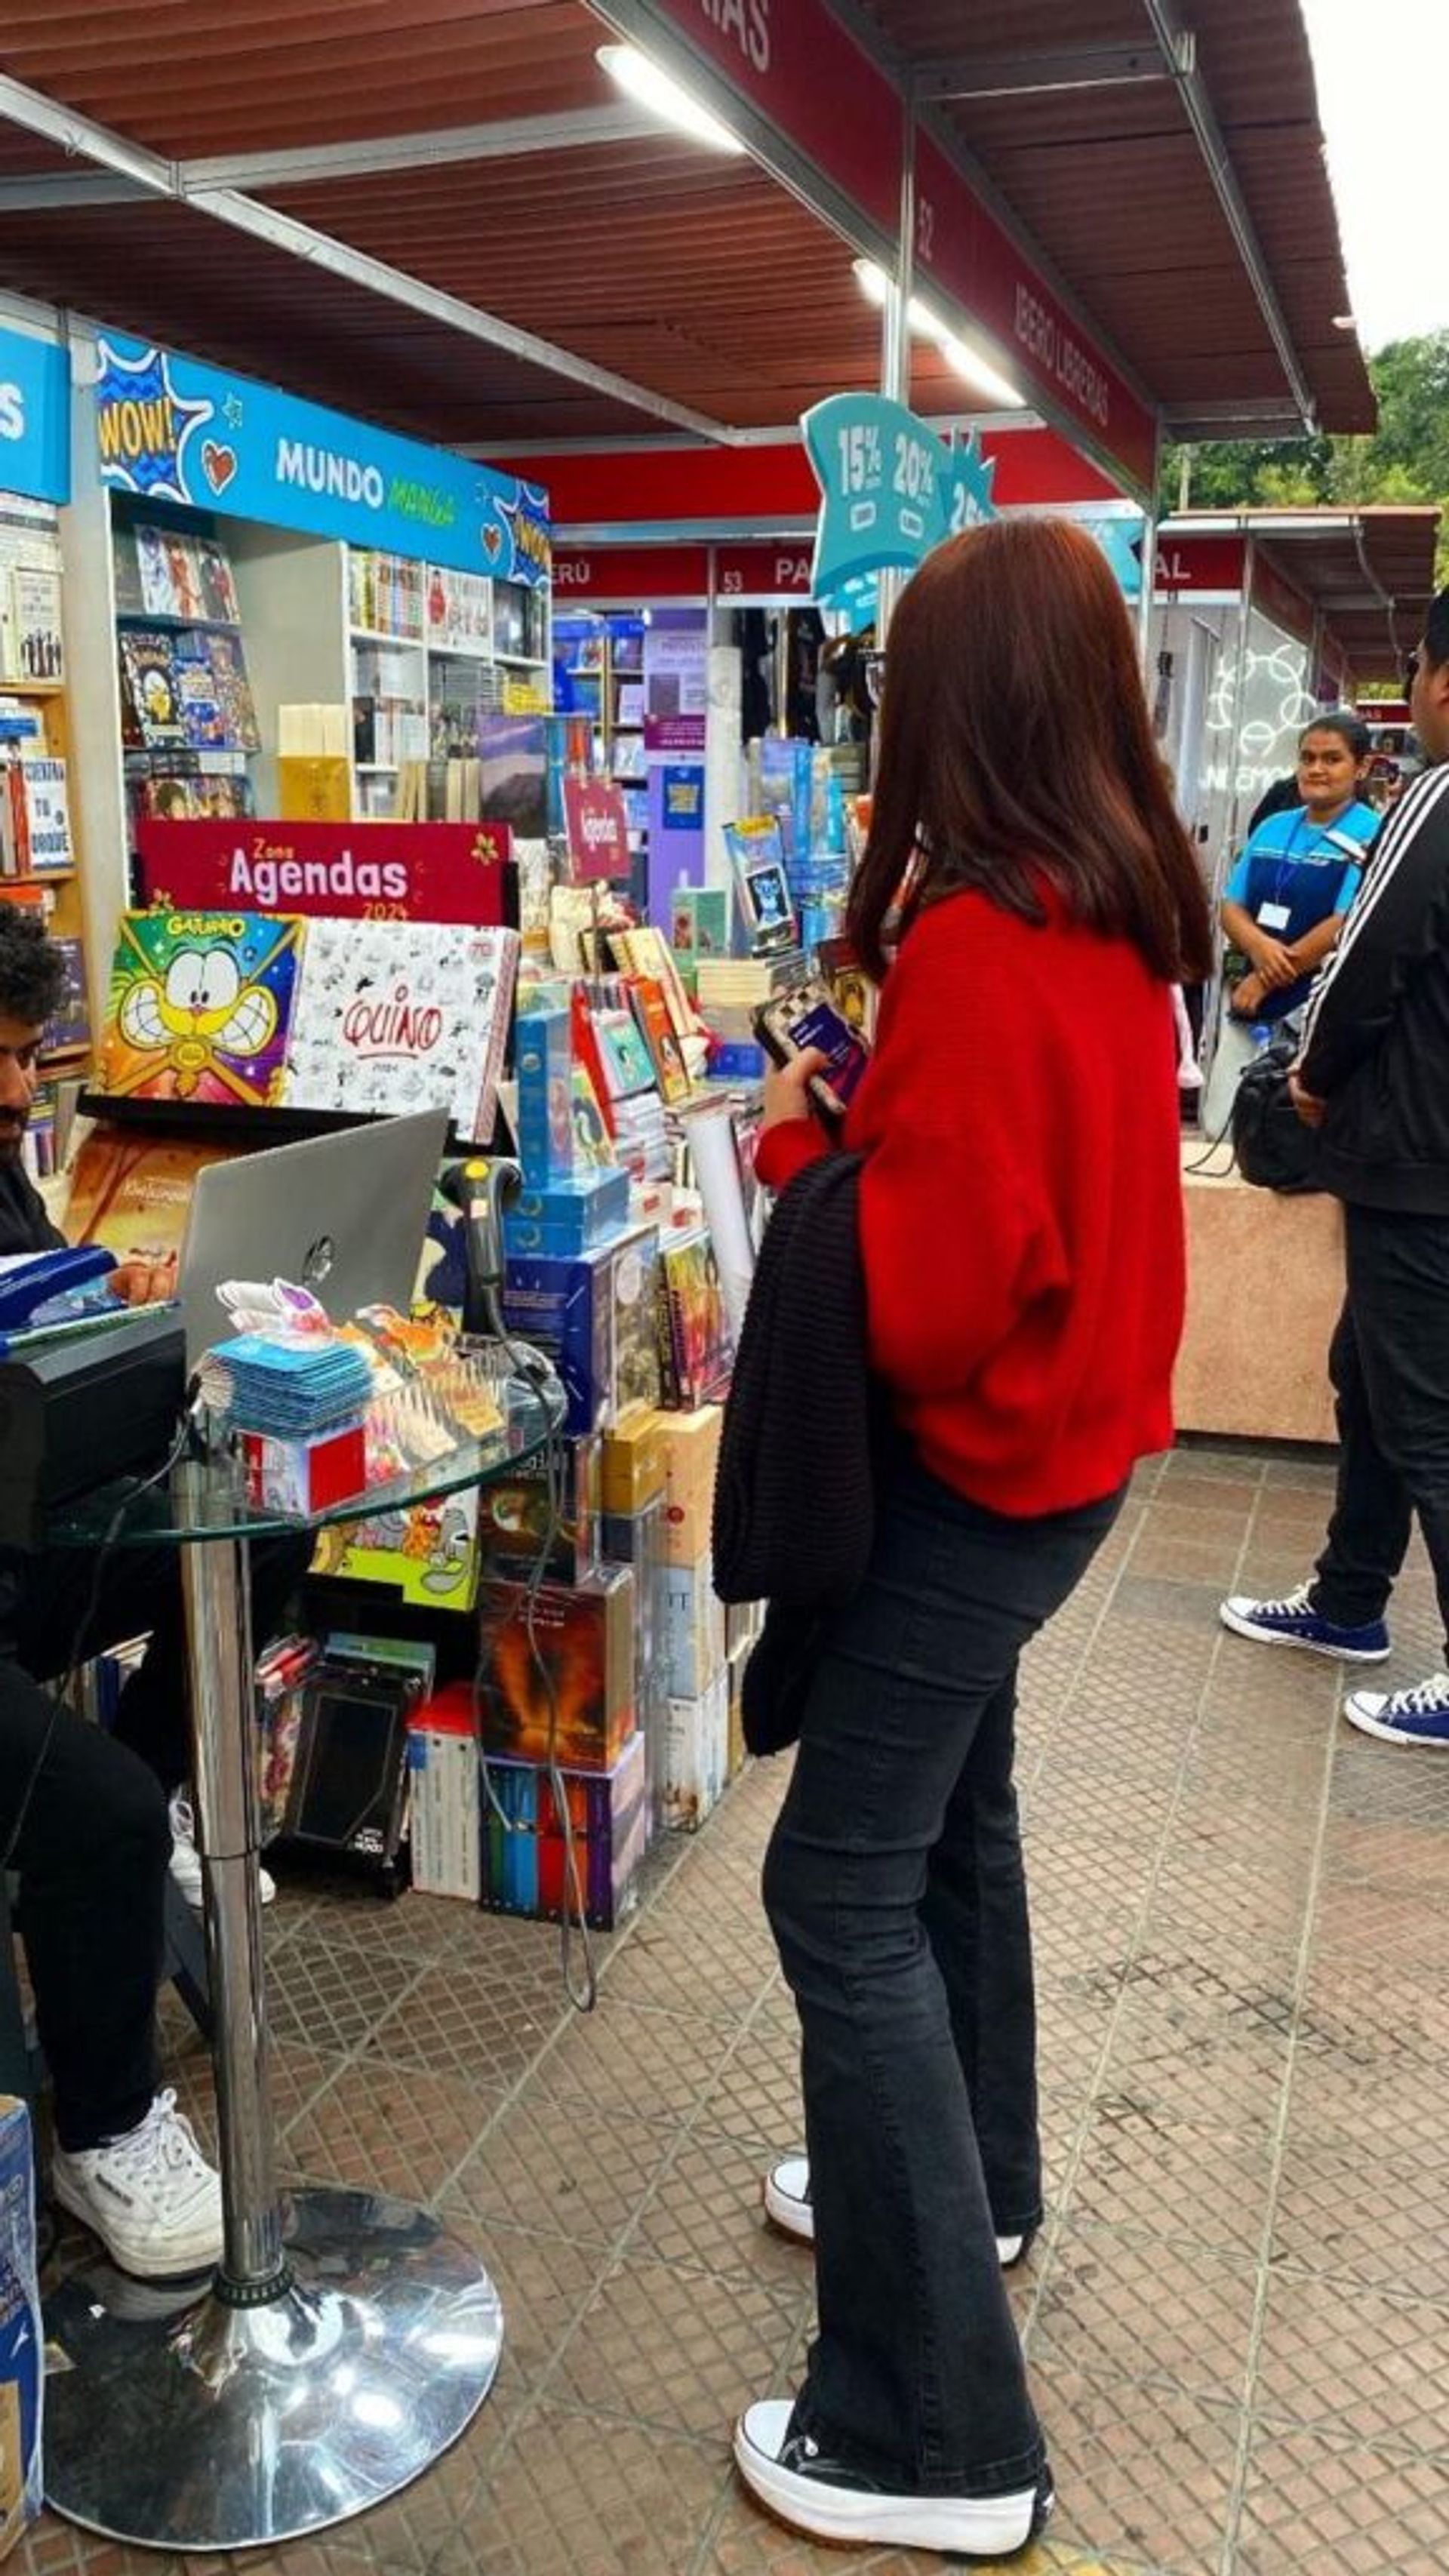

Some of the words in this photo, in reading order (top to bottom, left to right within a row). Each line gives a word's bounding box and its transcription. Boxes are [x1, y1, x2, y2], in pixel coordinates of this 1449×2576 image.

[99, 395, 176, 457] WOW!
[276, 437, 383, 509] MUNDO
[724, 571, 743, 593] 53
[230, 847, 408, 905] Agendas
[343, 983, 443, 1051] QUINO
